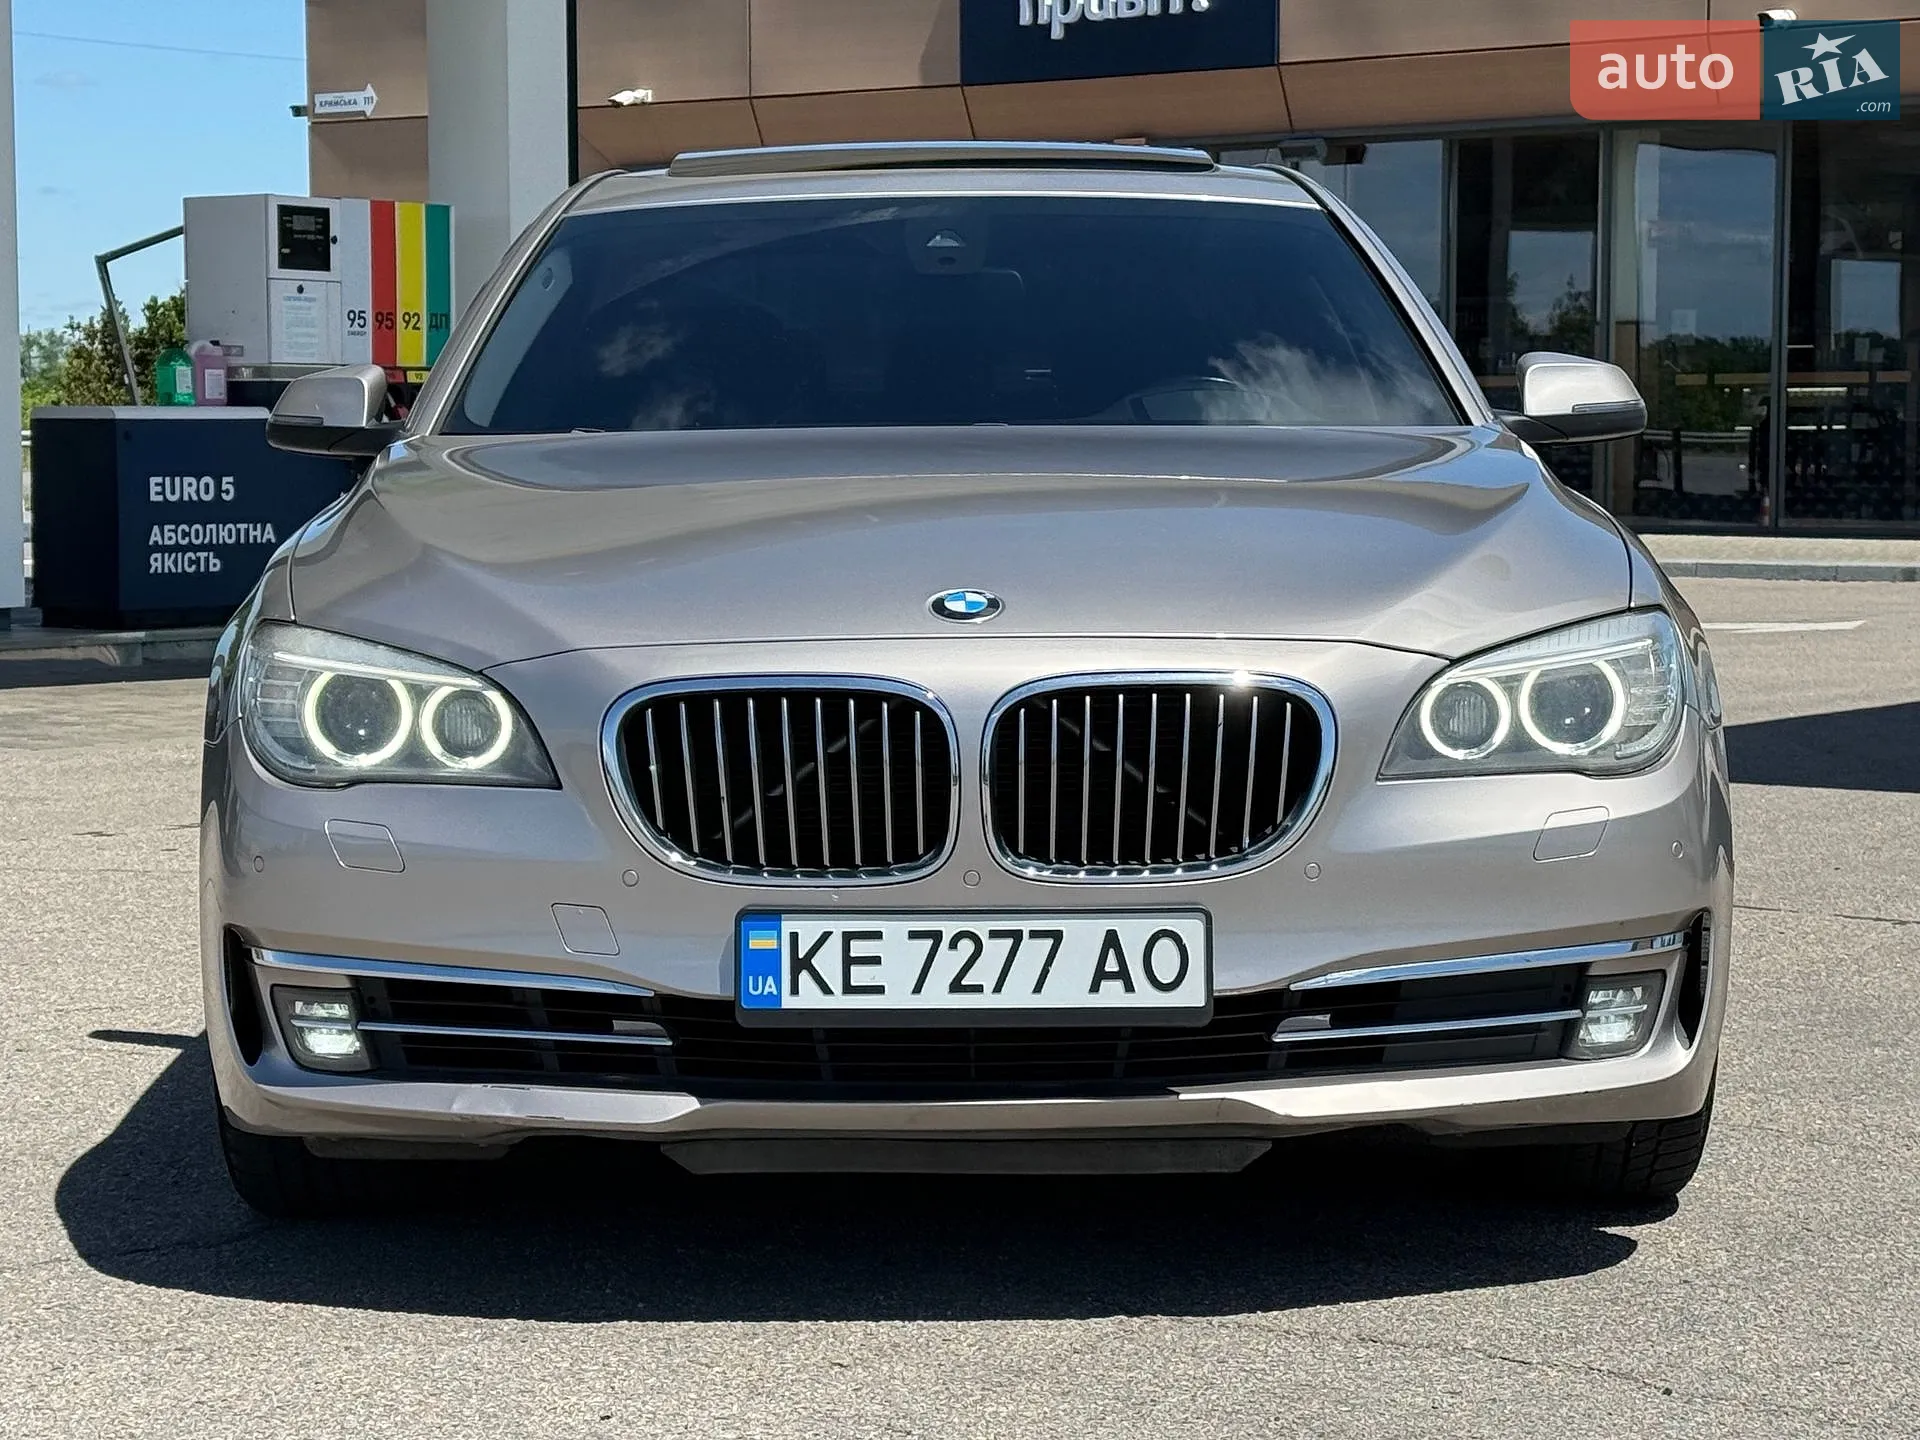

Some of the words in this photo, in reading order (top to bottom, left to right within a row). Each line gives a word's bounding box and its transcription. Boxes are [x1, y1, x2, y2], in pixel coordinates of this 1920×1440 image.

[347, 309, 367, 329] 95
[375, 311, 395, 331] 95
[402, 311, 422, 331] 92
[429, 313, 449, 331] ДП
[149, 475, 215, 502] EURO
[221, 475, 235, 502] 5
[149, 523, 276, 545] АБСОЛЮТНА
[149, 551, 222, 574] ЯКІСТЬ
[789, 930, 886, 997] KE
[907, 928, 1064, 995] 7277
[1087, 927, 1190, 994] AO
[748, 975, 778, 996] UA
